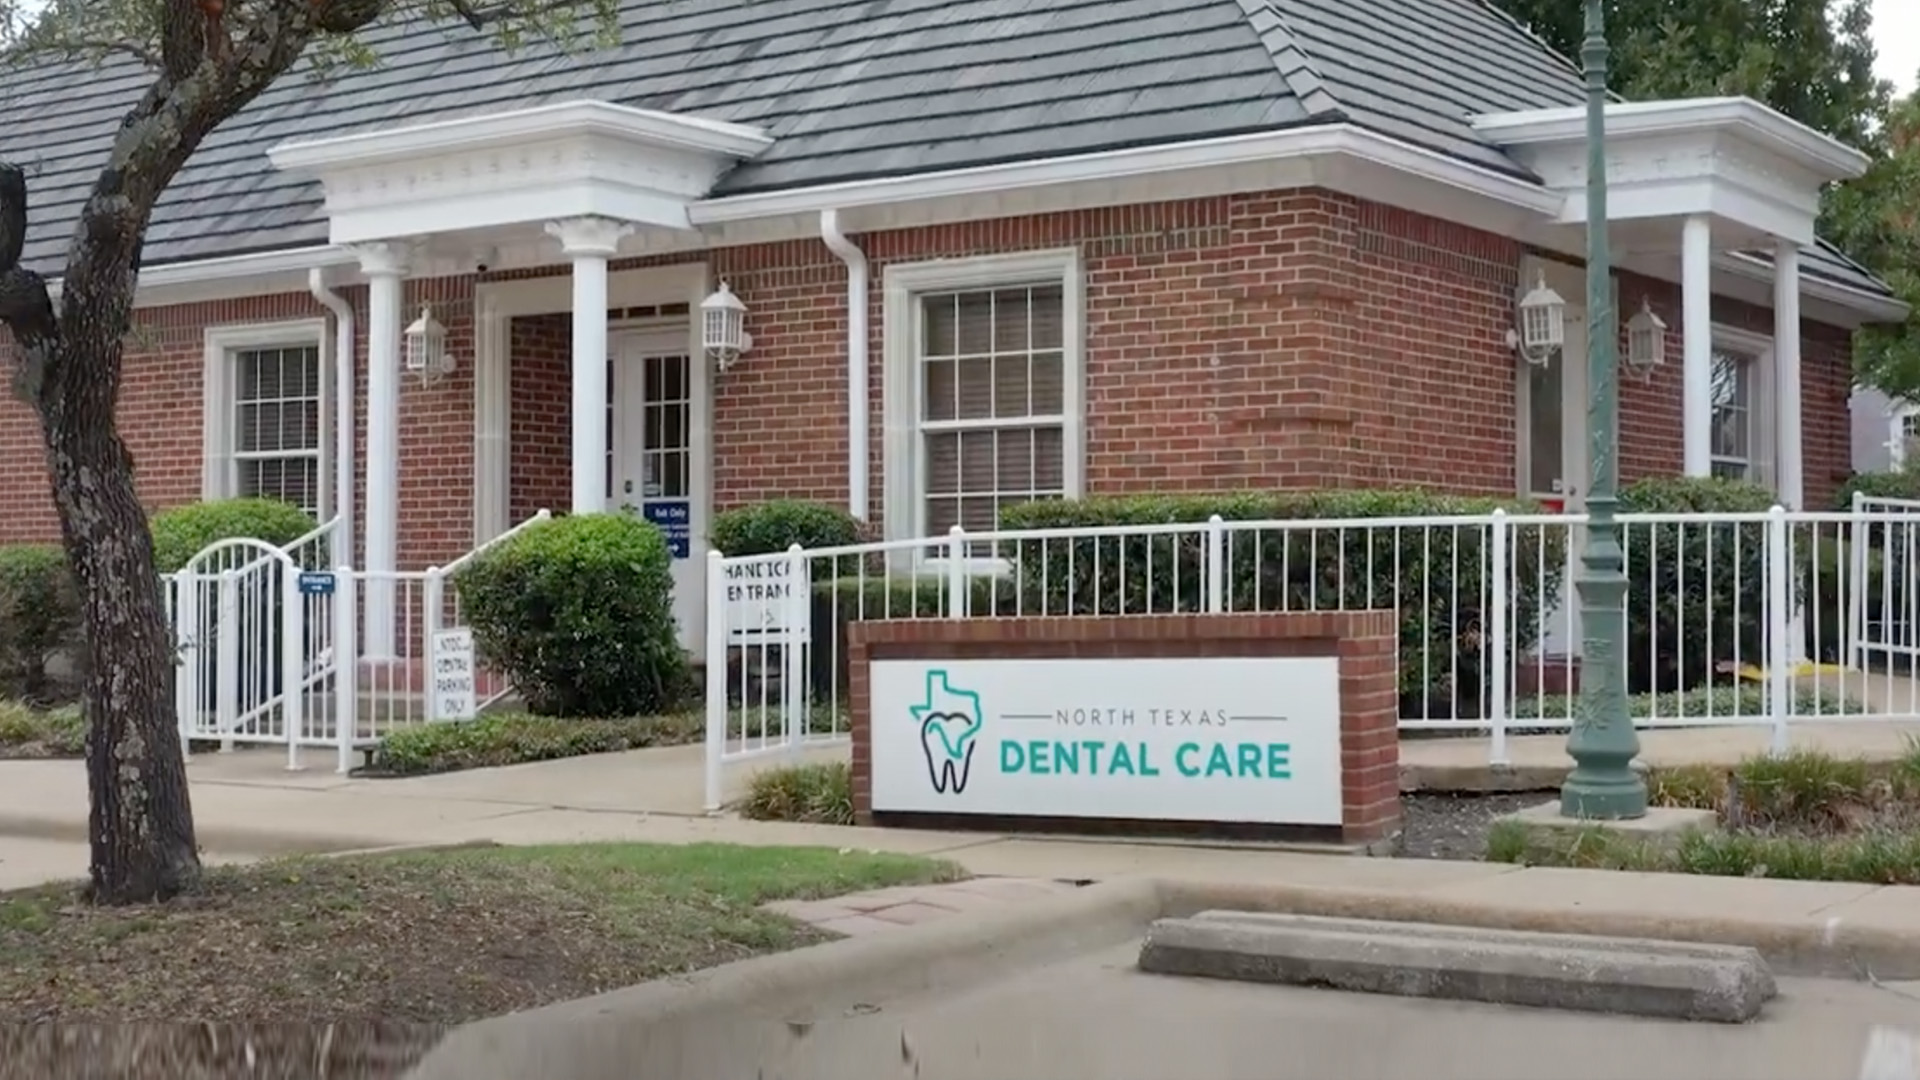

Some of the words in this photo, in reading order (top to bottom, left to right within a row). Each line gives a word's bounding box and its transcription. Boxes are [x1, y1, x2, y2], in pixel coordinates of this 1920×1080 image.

[669, 508, 686, 518] Only
[727, 584, 790, 601] ENTRANC
[436, 658, 469, 673] DENTAL
[436, 678, 471, 693] PARKING
[444, 699, 465, 714] ONLY
[1056, 708, 1135, 726] NORTH
[1149, 709, 1228, 727] TEXAS
[1000, 740, 1160, 777] DENTAL
[1175, 742, 1292, 779] CARE
